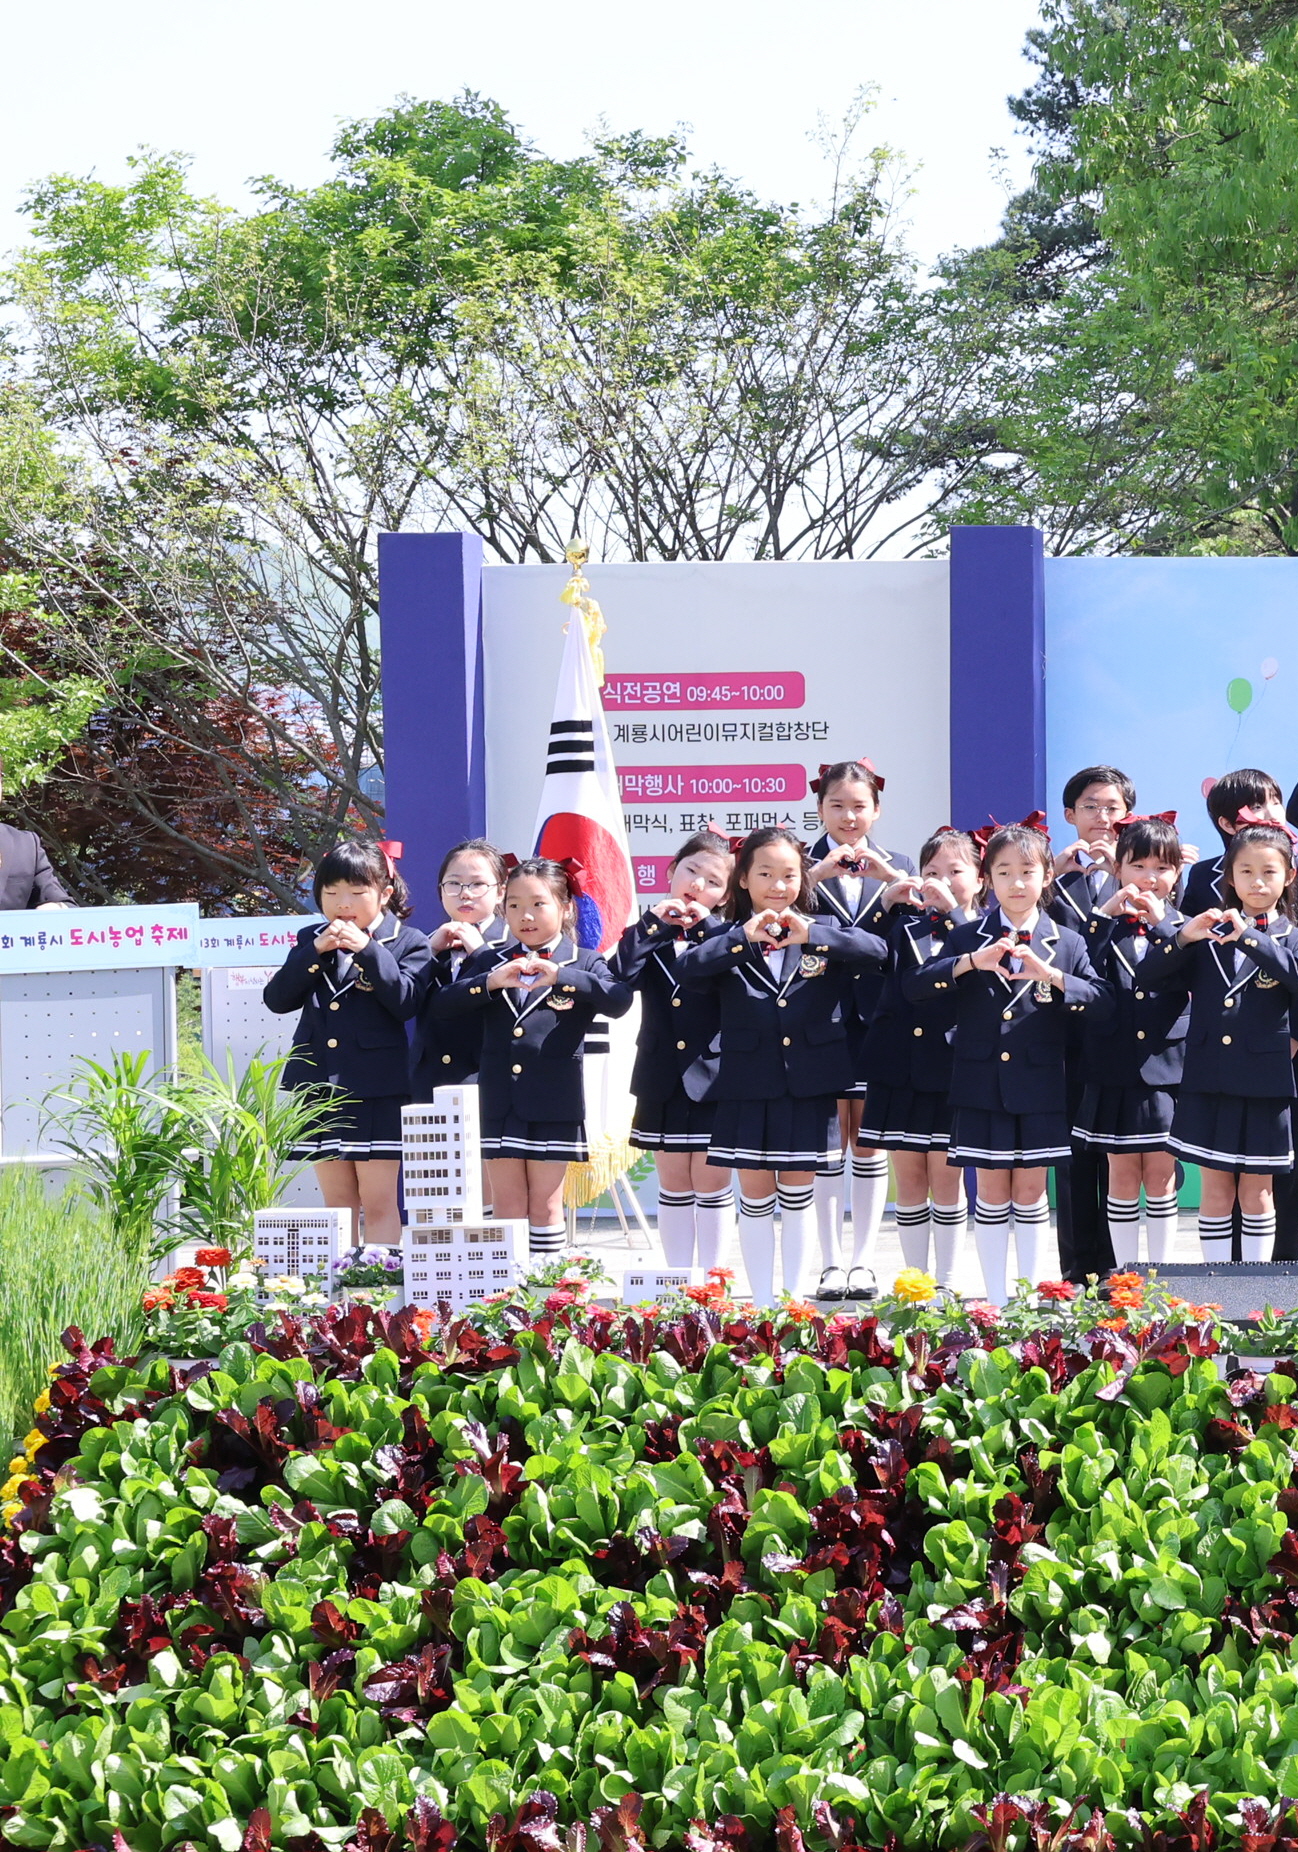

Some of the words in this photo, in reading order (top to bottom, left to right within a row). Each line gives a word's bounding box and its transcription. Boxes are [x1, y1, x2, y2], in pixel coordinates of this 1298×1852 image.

[602, 681, 682, 704] 식전공연
[686, 684, 784, 702] 09:45~10:00
[613, 721, 830, 743] 계룡시어린이뮤지컬합창단
[690, 777, 786, 794] 10:00~10:30
[20, 931, 63, 951] 계룡시
[70, 924, 144, 948] 도시농업
[150, 923, 188, 946] 축제
[224, 934, 255, 950] 계룡시
